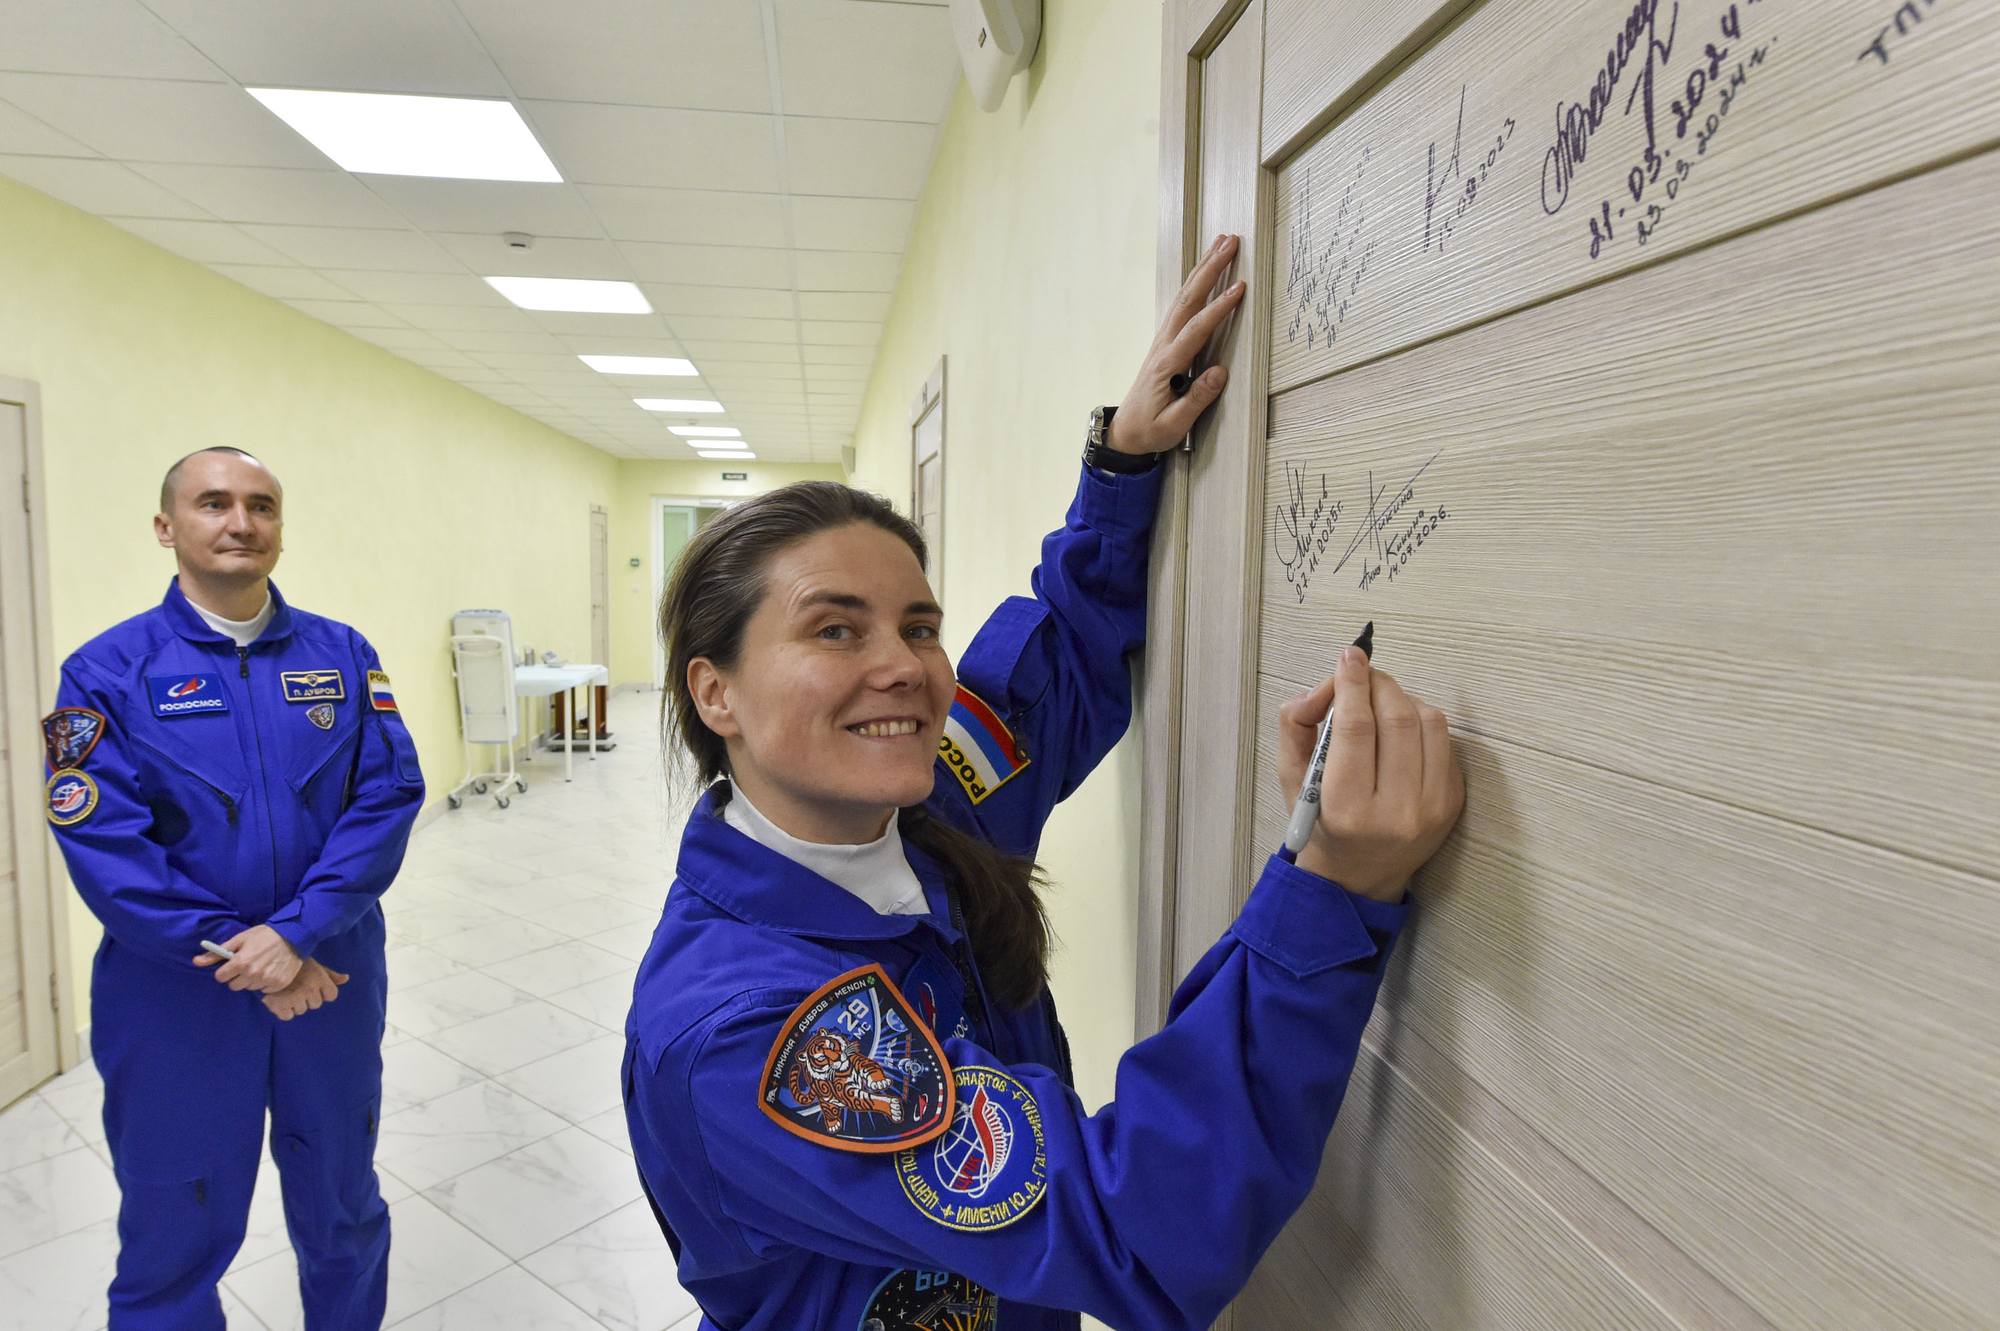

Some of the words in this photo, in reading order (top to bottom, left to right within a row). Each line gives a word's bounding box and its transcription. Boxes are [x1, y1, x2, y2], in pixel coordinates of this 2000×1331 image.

[1858, 0, 1935, 65] ТП
[160, 699, 223, 711] РОСКОСМОС
[939, 735, 987, 799] РОСС
[798, 1000, 829, 1033] ДУБРОВ
[834, 979, 867, 999] MENON
[837, 998, 870, 1032] 29
[853, 1021, 872, 1040] МС
[956, 1071, 1008, 1092] ОНАВТОВ
[907, 1175, 939, 1210] ЦЕНТР
[955, 1201, 1011, 1224] ИМЕНИ
